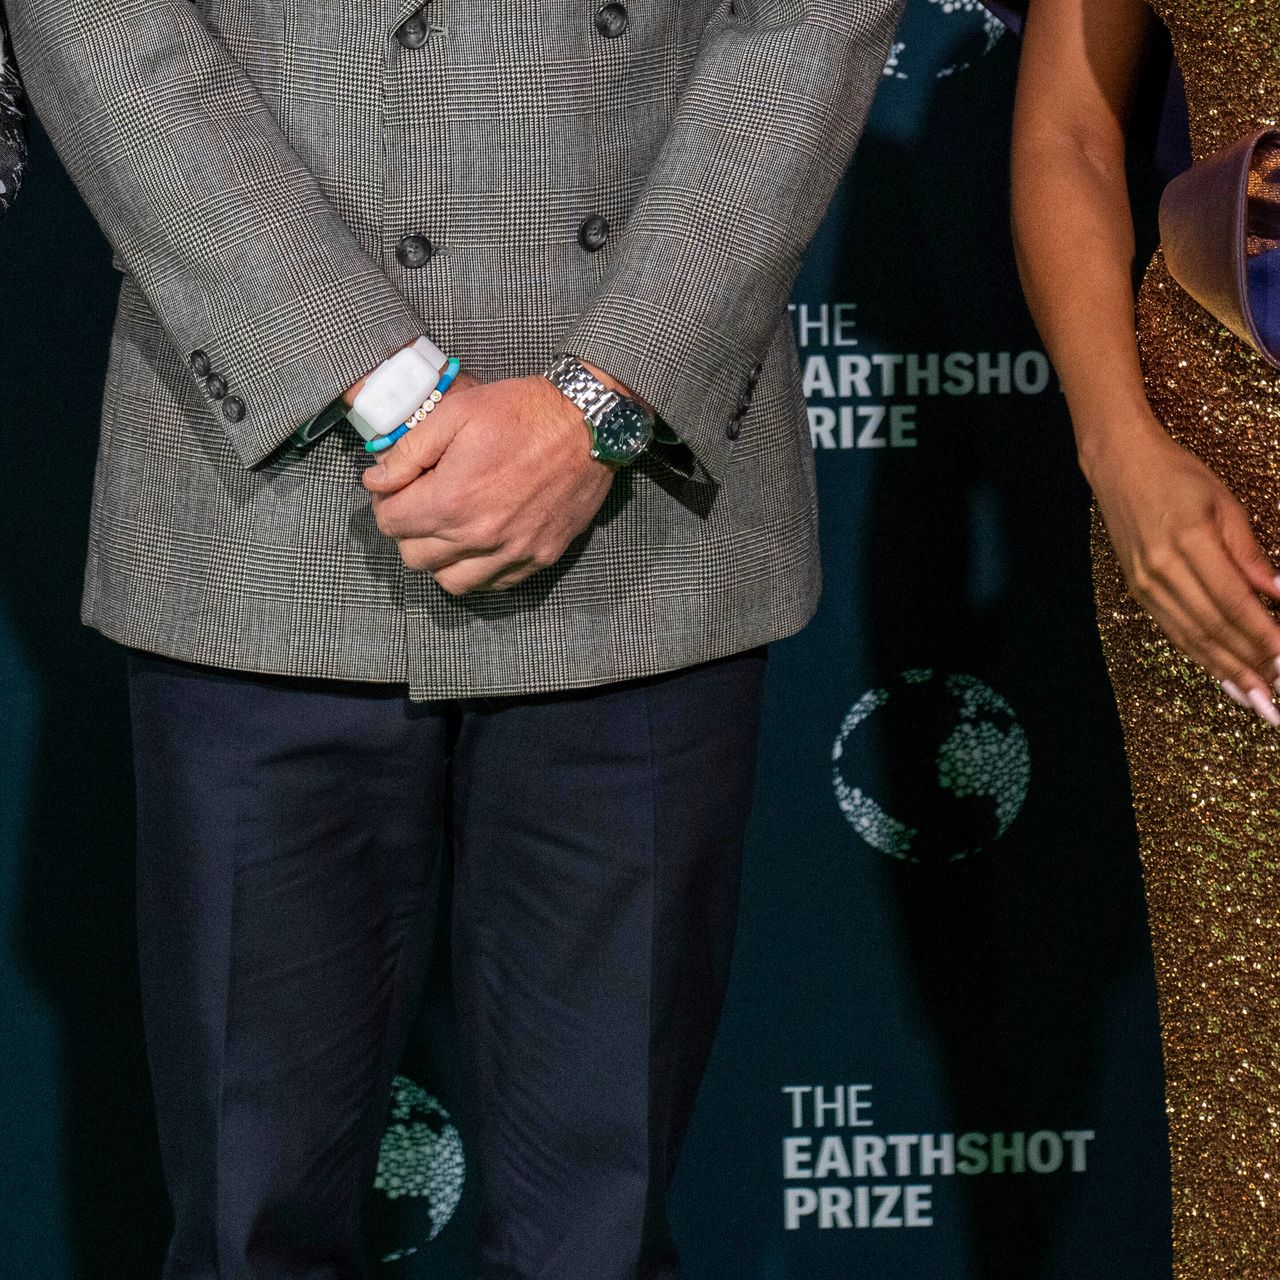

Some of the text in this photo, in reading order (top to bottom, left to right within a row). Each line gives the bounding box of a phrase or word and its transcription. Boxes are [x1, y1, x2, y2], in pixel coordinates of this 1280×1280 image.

[803, 350, 1064, 397] ARTHSHO
[783, 1084, 873, 1128] THE
[783, 1131, 1094, 1179] EARTHSHOT
[785, 1185, 933, 1230] PRIZE
